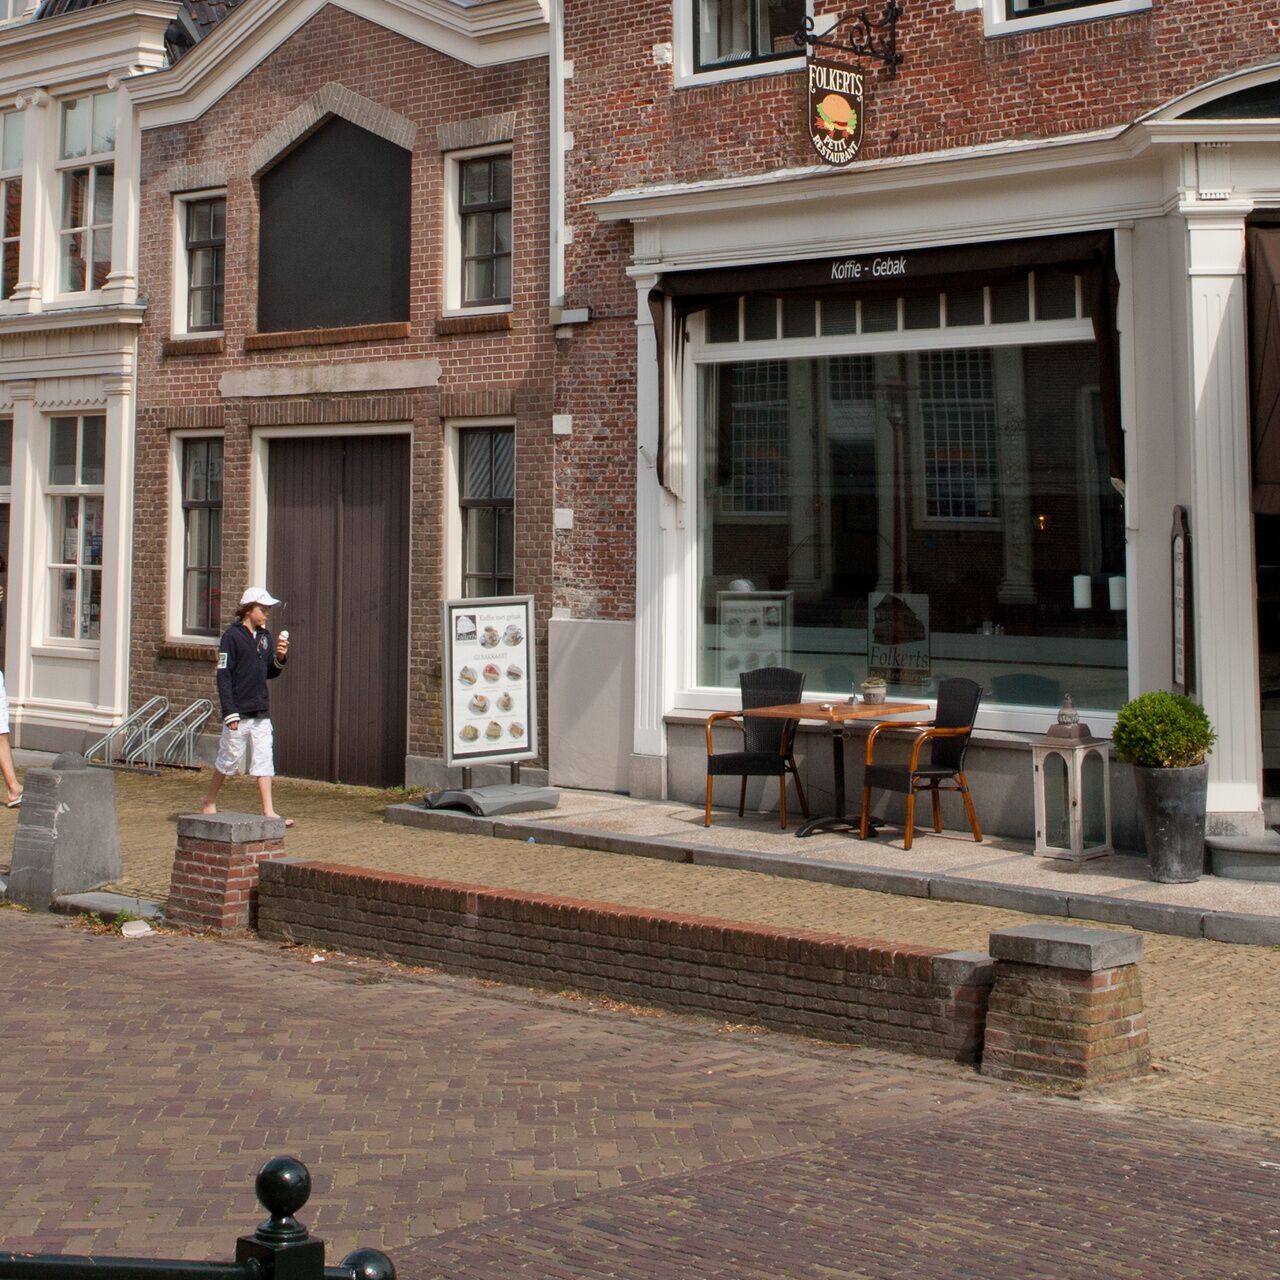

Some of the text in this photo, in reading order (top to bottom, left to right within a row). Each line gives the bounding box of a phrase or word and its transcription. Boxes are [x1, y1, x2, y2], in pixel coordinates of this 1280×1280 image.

[809, 65, 863, 99] FOLKERTS
[813, 134, 858, 163] RESTAURANT
[823, 134, 847, 151] PETIT
[831, 260, 861, 279] Koffie
[872, 256, 907, 276] Gebak
[870, 645, 929, 669] Folkerts
